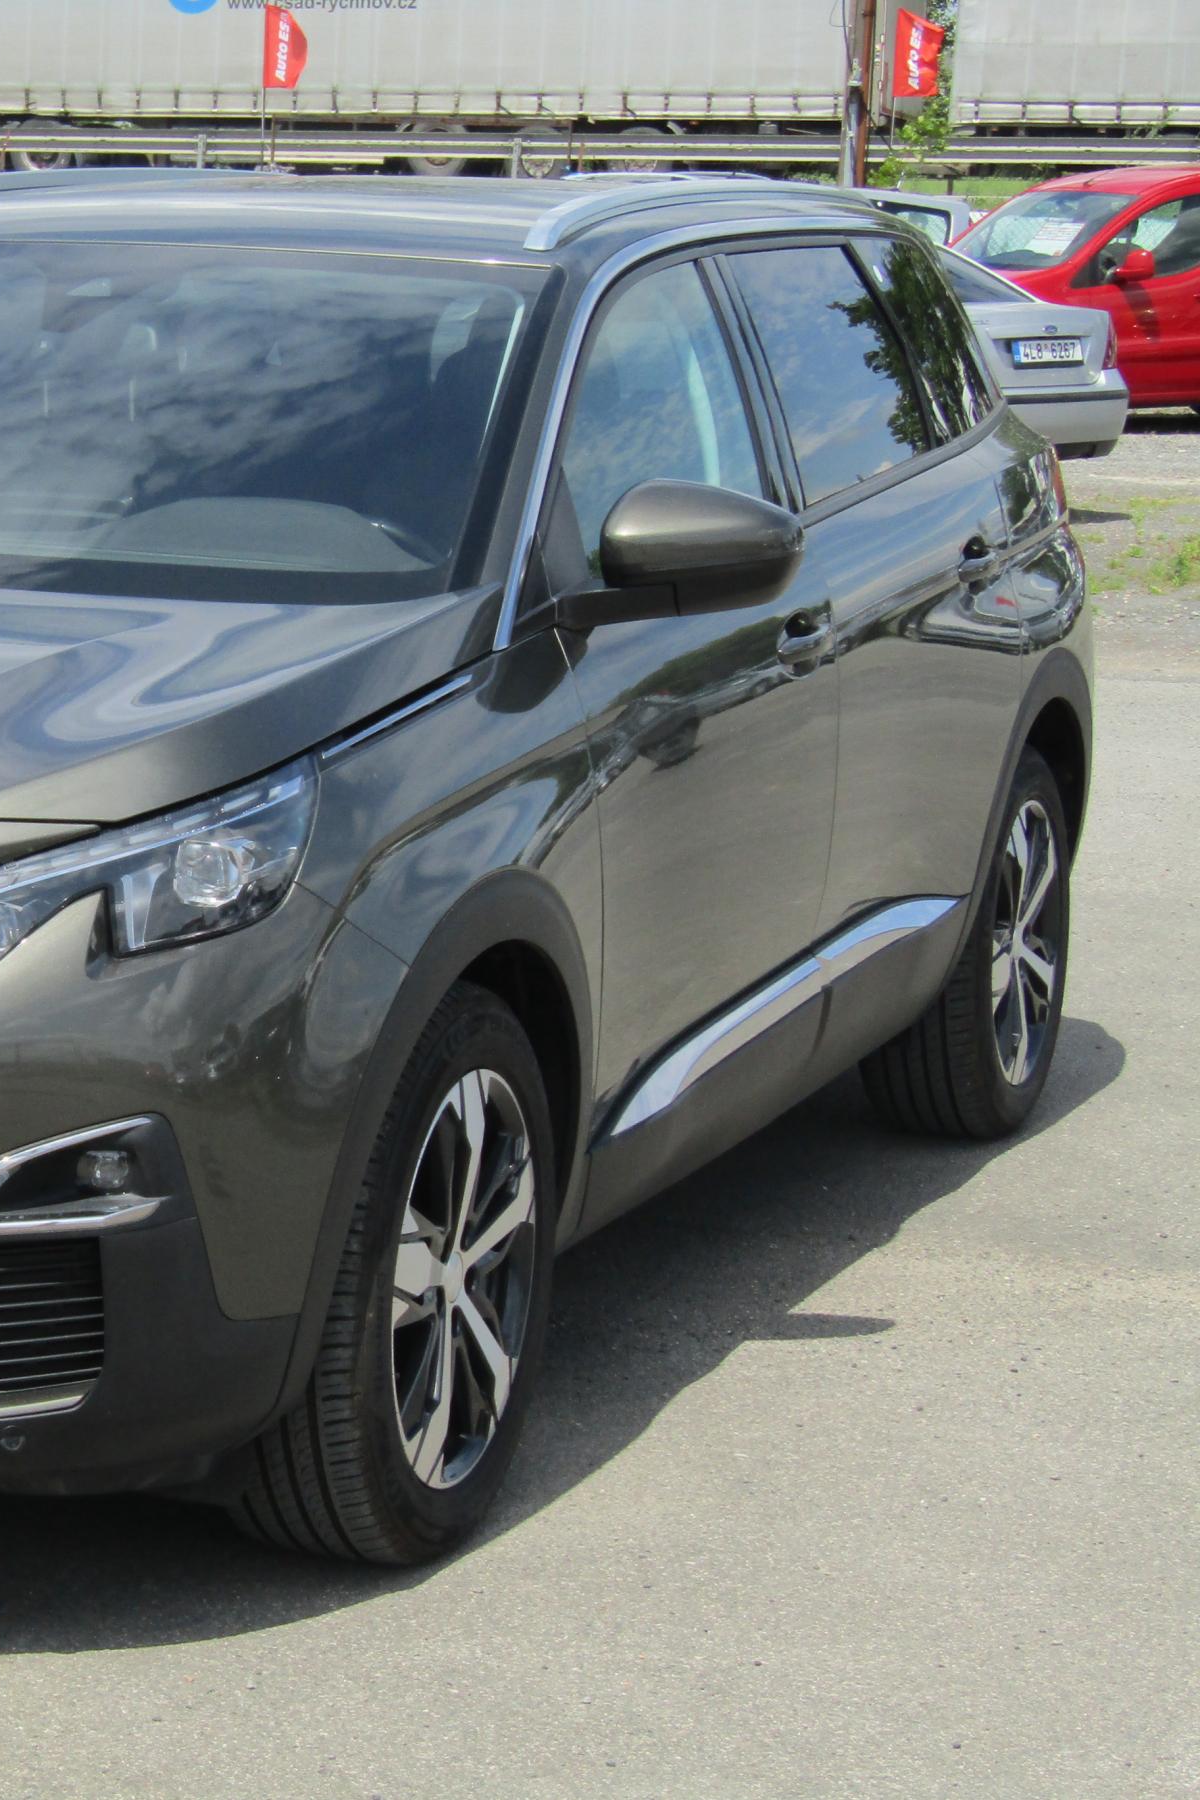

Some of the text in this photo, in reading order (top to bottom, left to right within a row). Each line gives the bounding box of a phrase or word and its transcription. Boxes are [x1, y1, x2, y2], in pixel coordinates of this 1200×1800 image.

[228, 0, 417, 13] wwwcsad-rychnov.cz
[275, 42, 289, 82] Auto
[907, 49, 920, 91] Auto
[1022, 342, 1076, 360] 4L8 6267
